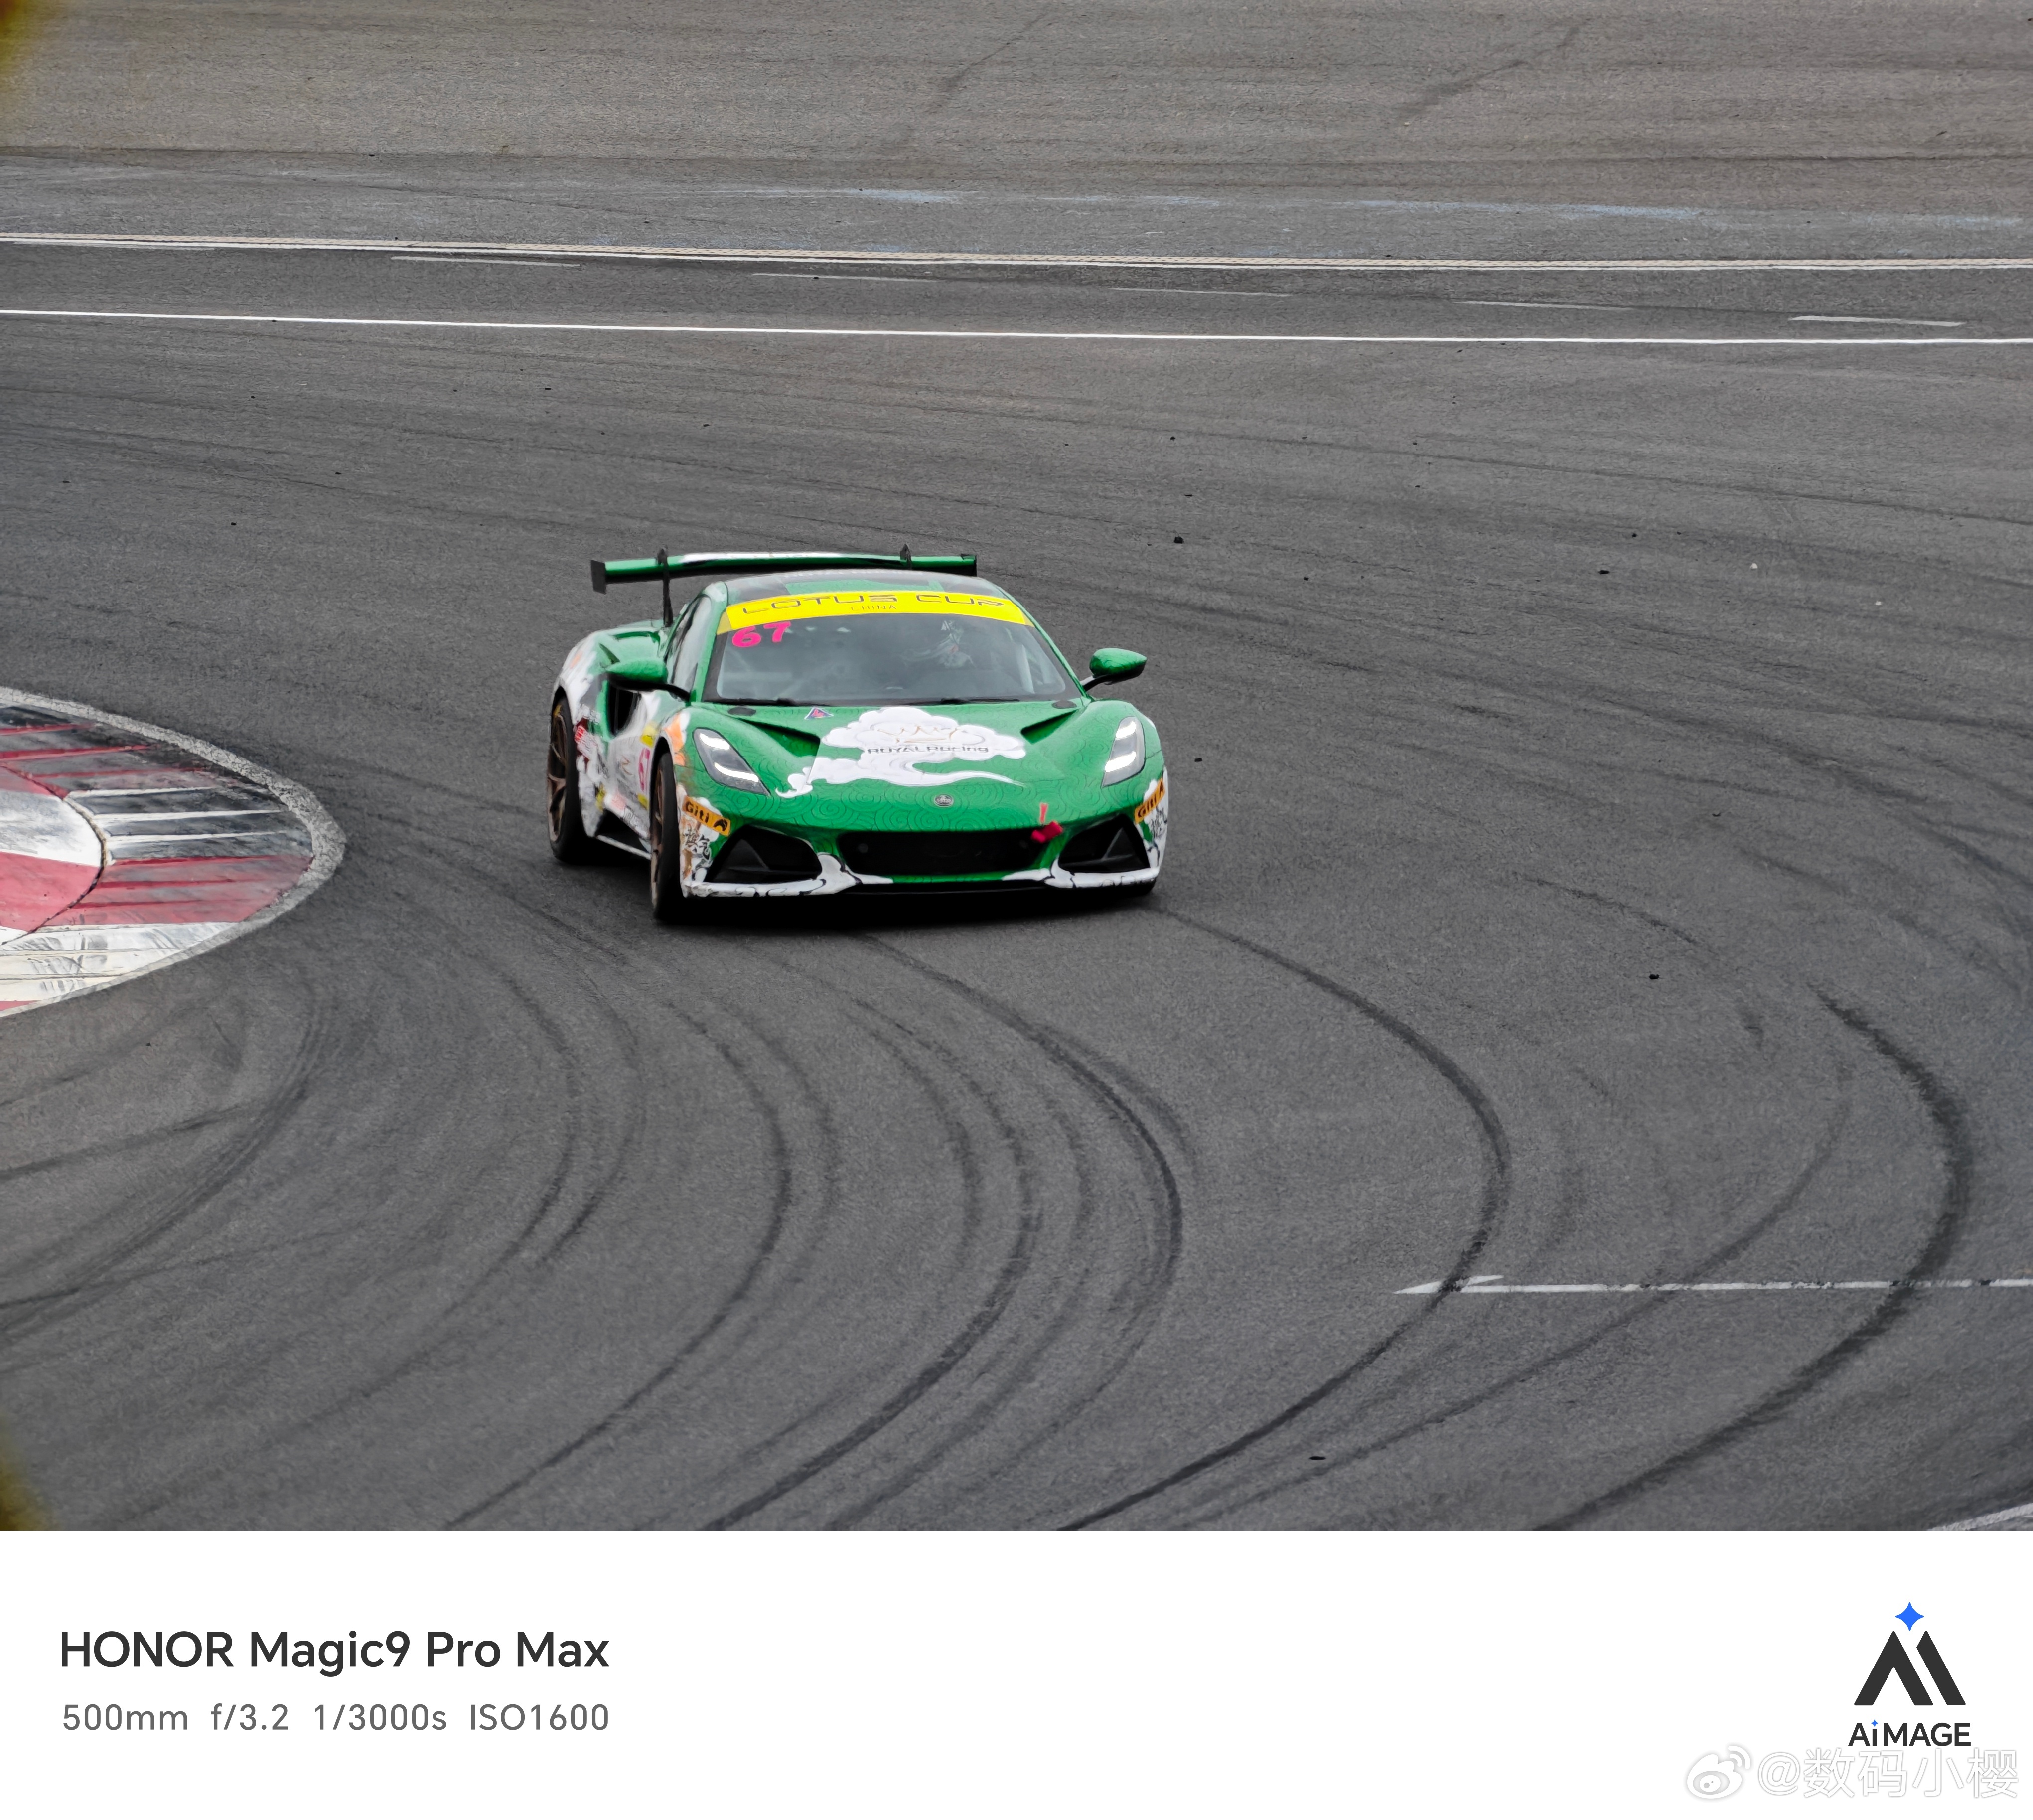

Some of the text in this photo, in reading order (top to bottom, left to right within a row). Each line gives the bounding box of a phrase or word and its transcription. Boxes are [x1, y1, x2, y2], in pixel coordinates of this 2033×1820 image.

[743, 594, 1004, 614] LOTUS CUP
[731, 621, 791, 647] 67
[685, 800, 710, 823] Giti
